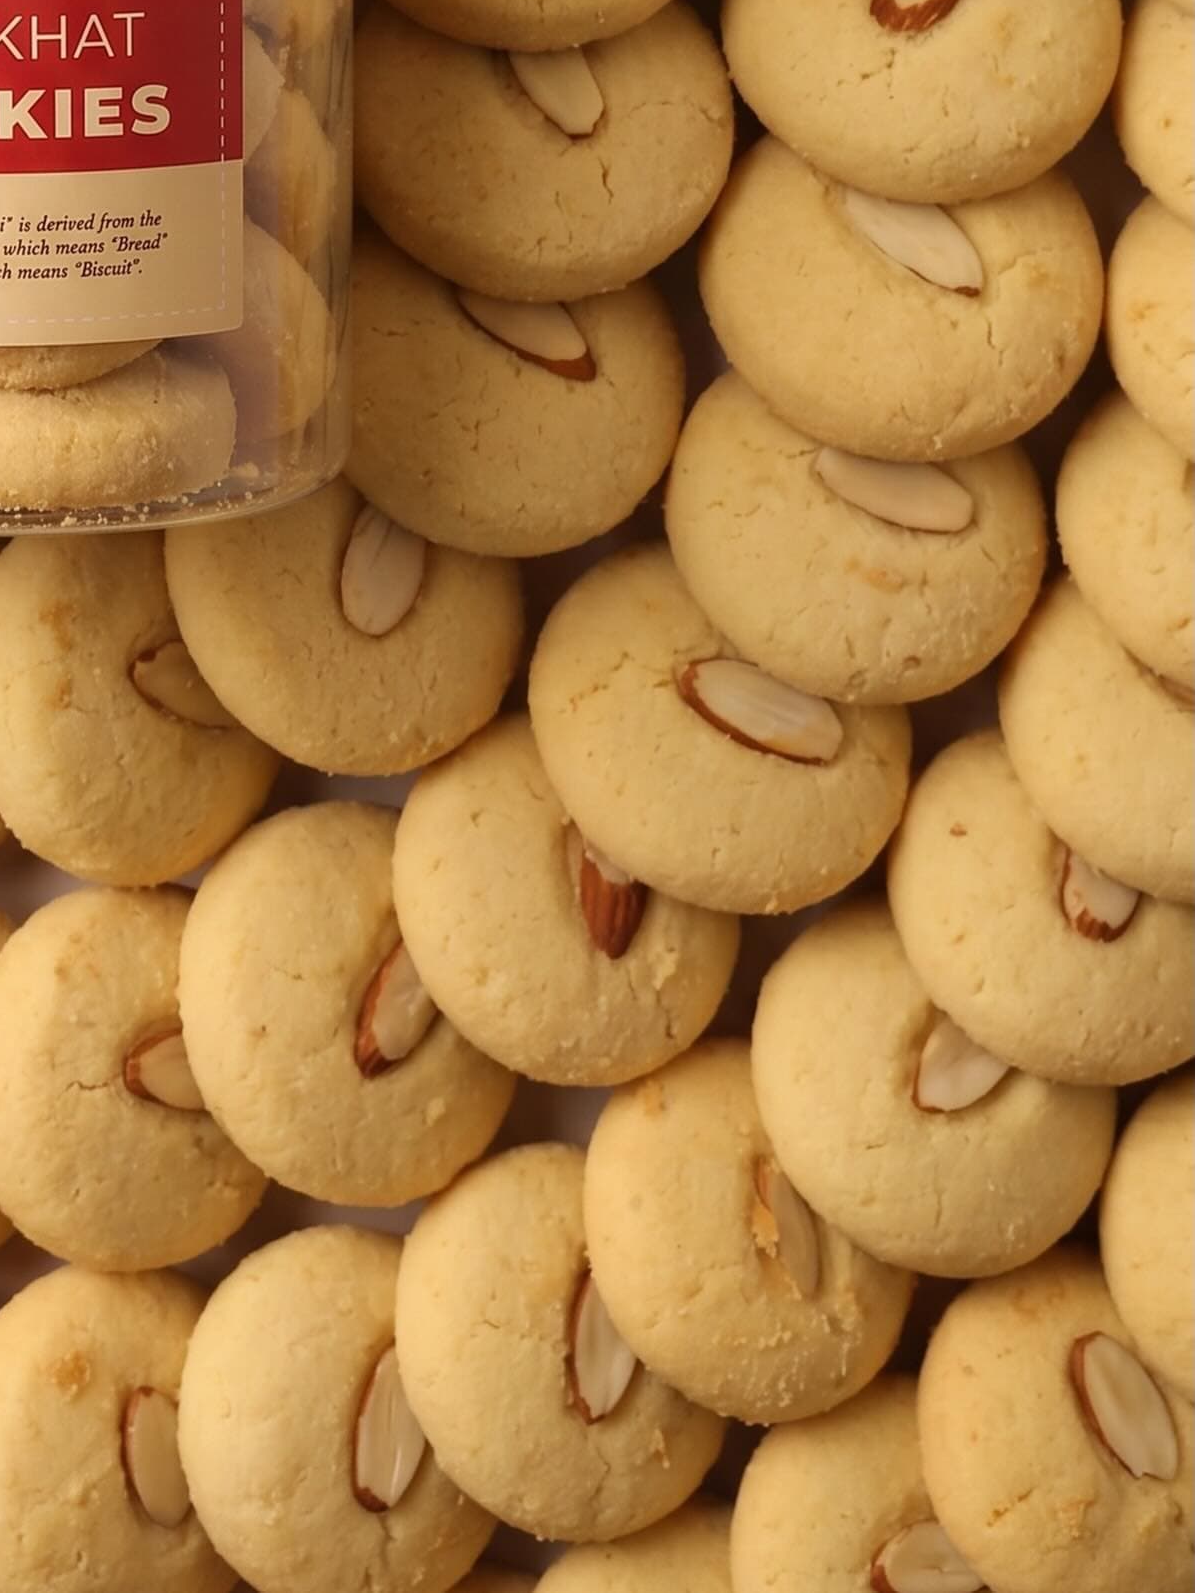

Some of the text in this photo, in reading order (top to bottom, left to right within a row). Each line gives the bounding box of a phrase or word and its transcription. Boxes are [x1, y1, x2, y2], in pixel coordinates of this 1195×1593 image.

[18, 217, 31, 232] is
[36, 213, 95, 232] derived
[97, 212, 134, 234] from
[139, 209, 162, 227] the
[3, 239, 50, 255] which
[56, 241, 105, 255] means
[17, 266, 68, 280] means
